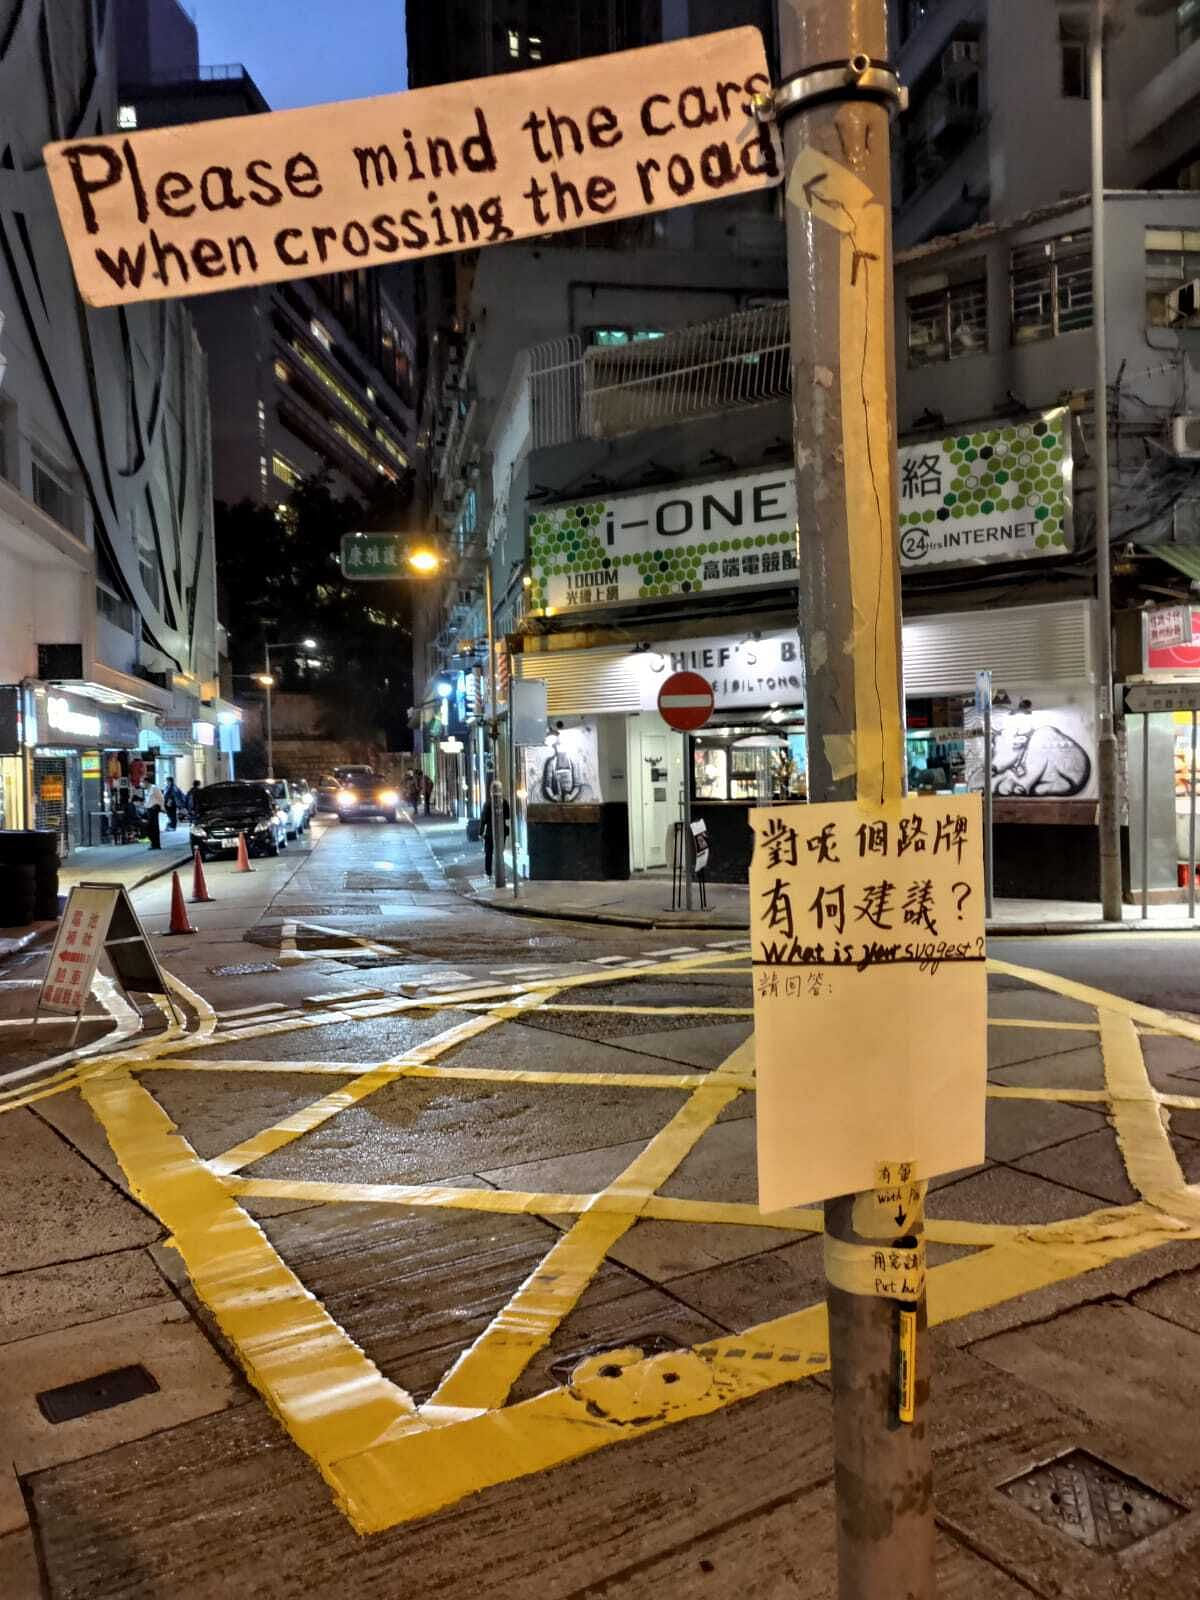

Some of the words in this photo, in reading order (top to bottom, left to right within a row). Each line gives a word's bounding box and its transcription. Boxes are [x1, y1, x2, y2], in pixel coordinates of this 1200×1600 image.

[62, 141, 324, 234] Please
[354, 108, 494, 189] mind
[522, 106, 624, 164] the
[640, 72, 770, 137] cars
[95, 228, 258, 289] when
[275, 191, 514, 266] crossing
[524, 175, 618, 228] the
[637, 122, 778, 205] road
[944, 521, 1038, 548] INTERNET
[566, 569, 619, 589] 1000M
[761, 936, 824, 963] What
[833, 941, 853, 963] is
